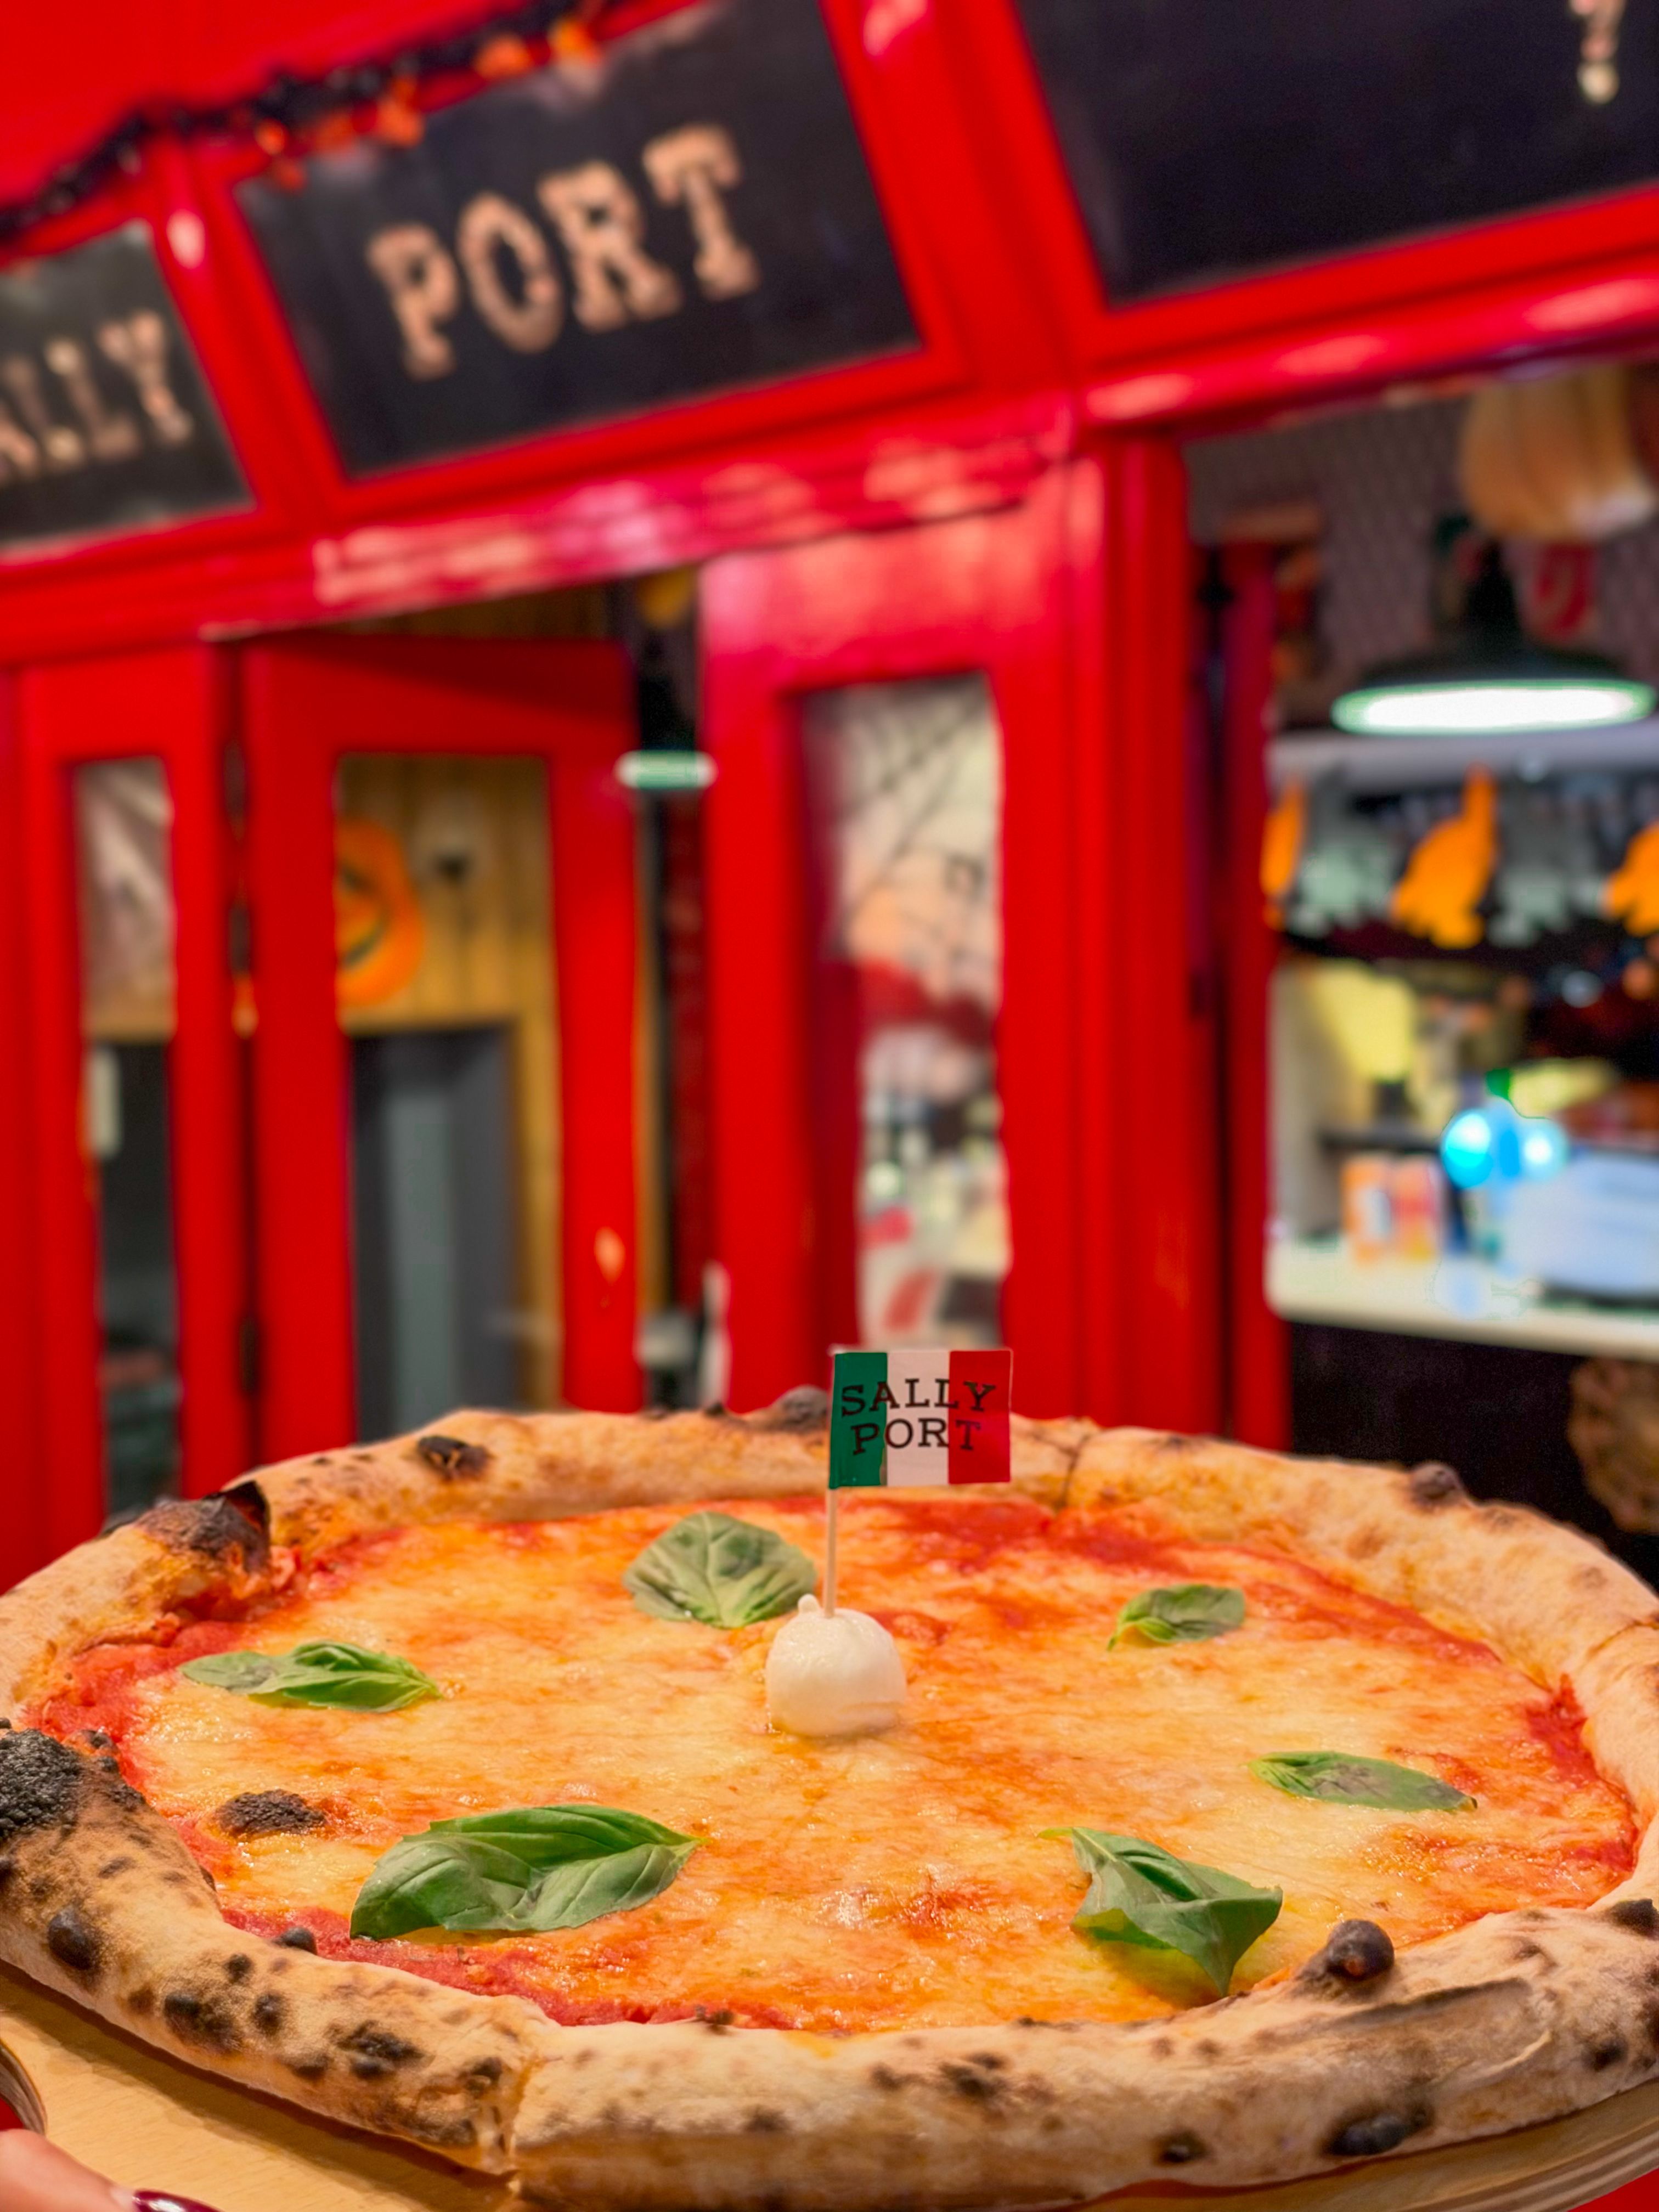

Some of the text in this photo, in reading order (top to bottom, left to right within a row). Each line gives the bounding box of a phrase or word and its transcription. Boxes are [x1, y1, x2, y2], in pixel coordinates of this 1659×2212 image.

[366, 124, 760, 381] PORT
[842, 1378, 996, 1418] SALLY
[851, 1418, 981, 1455] PORT
